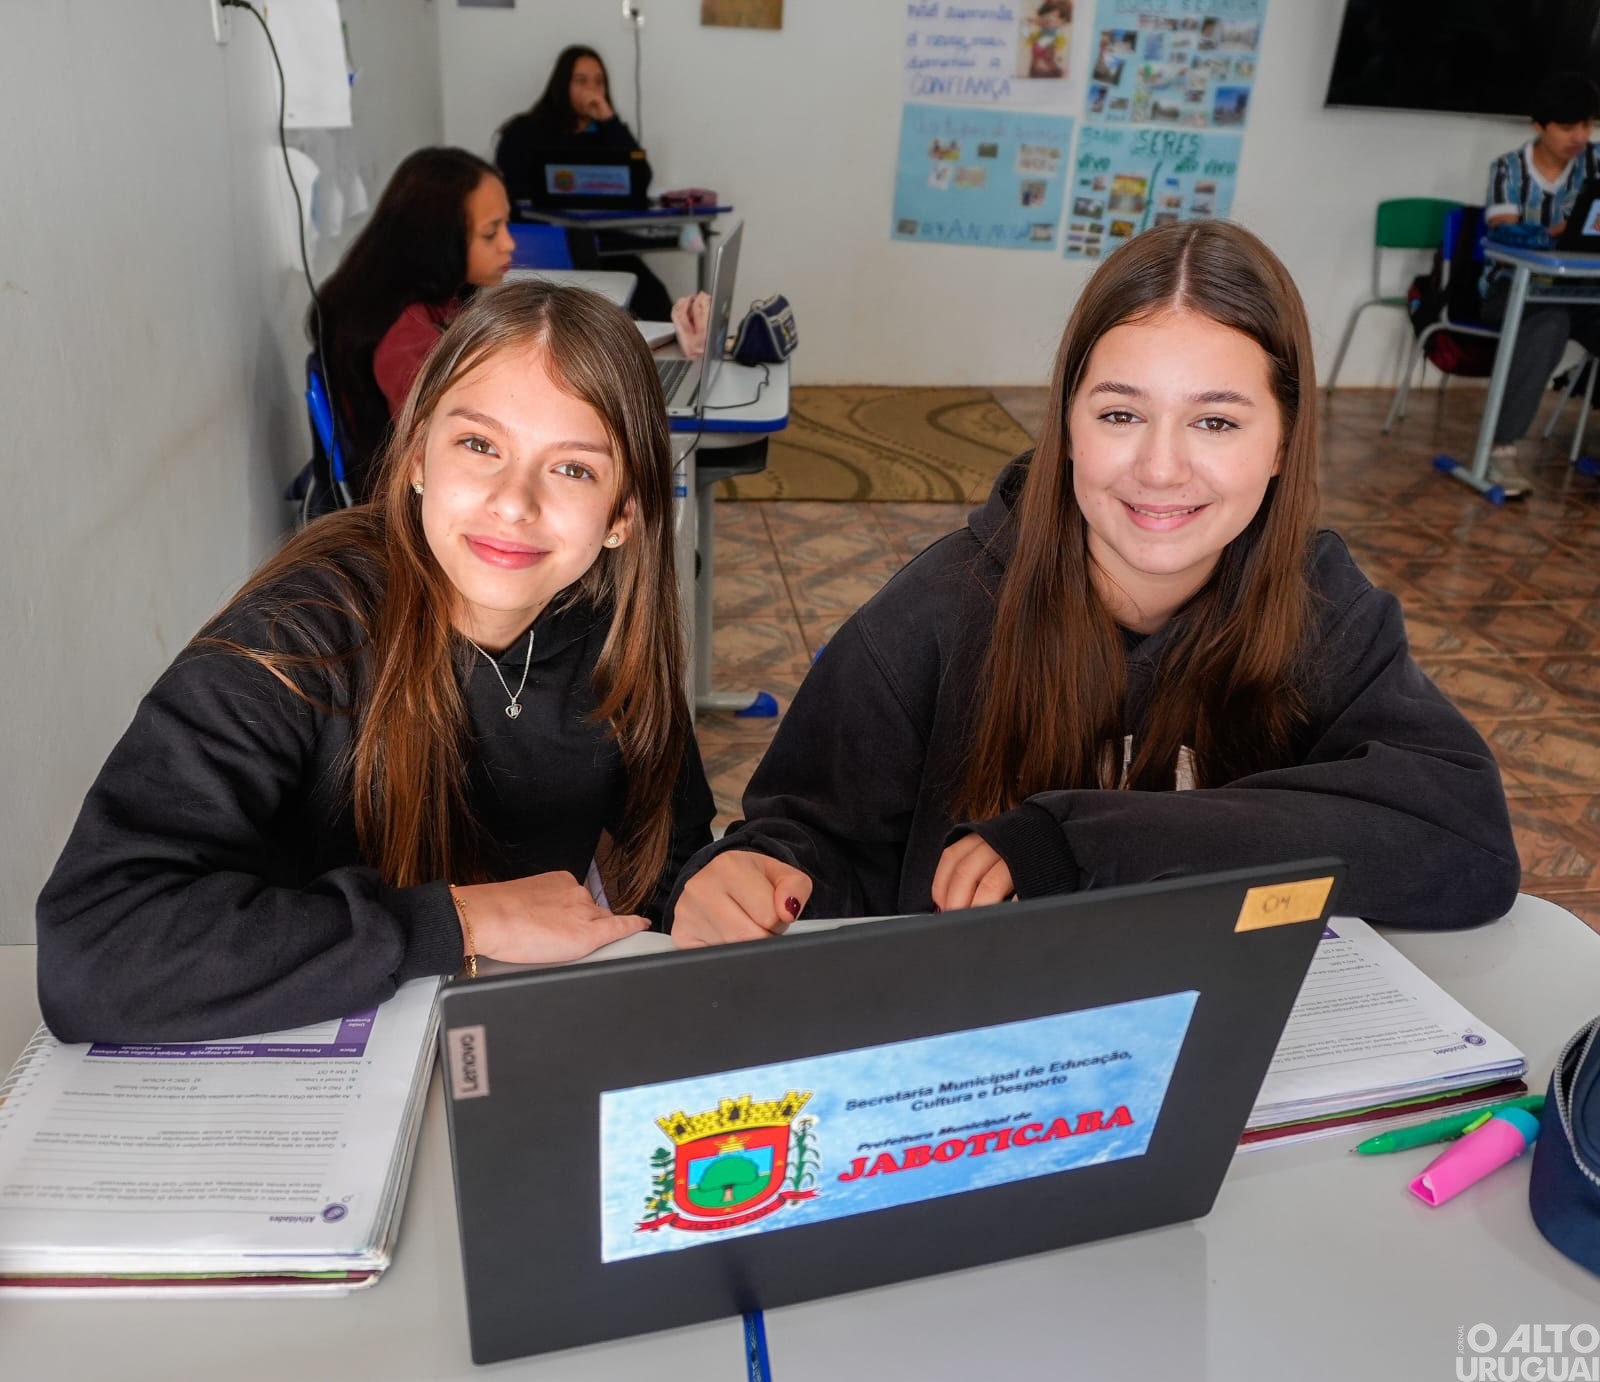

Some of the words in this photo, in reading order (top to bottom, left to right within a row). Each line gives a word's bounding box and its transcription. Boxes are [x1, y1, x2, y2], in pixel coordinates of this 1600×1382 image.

[459, 1034, 479, 1093] Lenovo
[845, 1085, 933, 1112] Secretaria
[938, 1069, 1020, 1094] Municipal
[1024, 1064, 1045, 1078] de
[1049, 1049, 1133, 1073] Educação,
[911, 1092, 973, 1112] Cultura
[977, 1088, 988, 1100] e
[992, 1074, 1068, 1098] Desporto
[837, 1105, 1135, 1183] JABOTICABA
[857, 1131, 933, 1152] Prefeitura
[937, 1115, 1011, 1137] Municipal
[1013, 1112, 1033, 1122] de
[269, 1215, 316, 1224] Atividades
